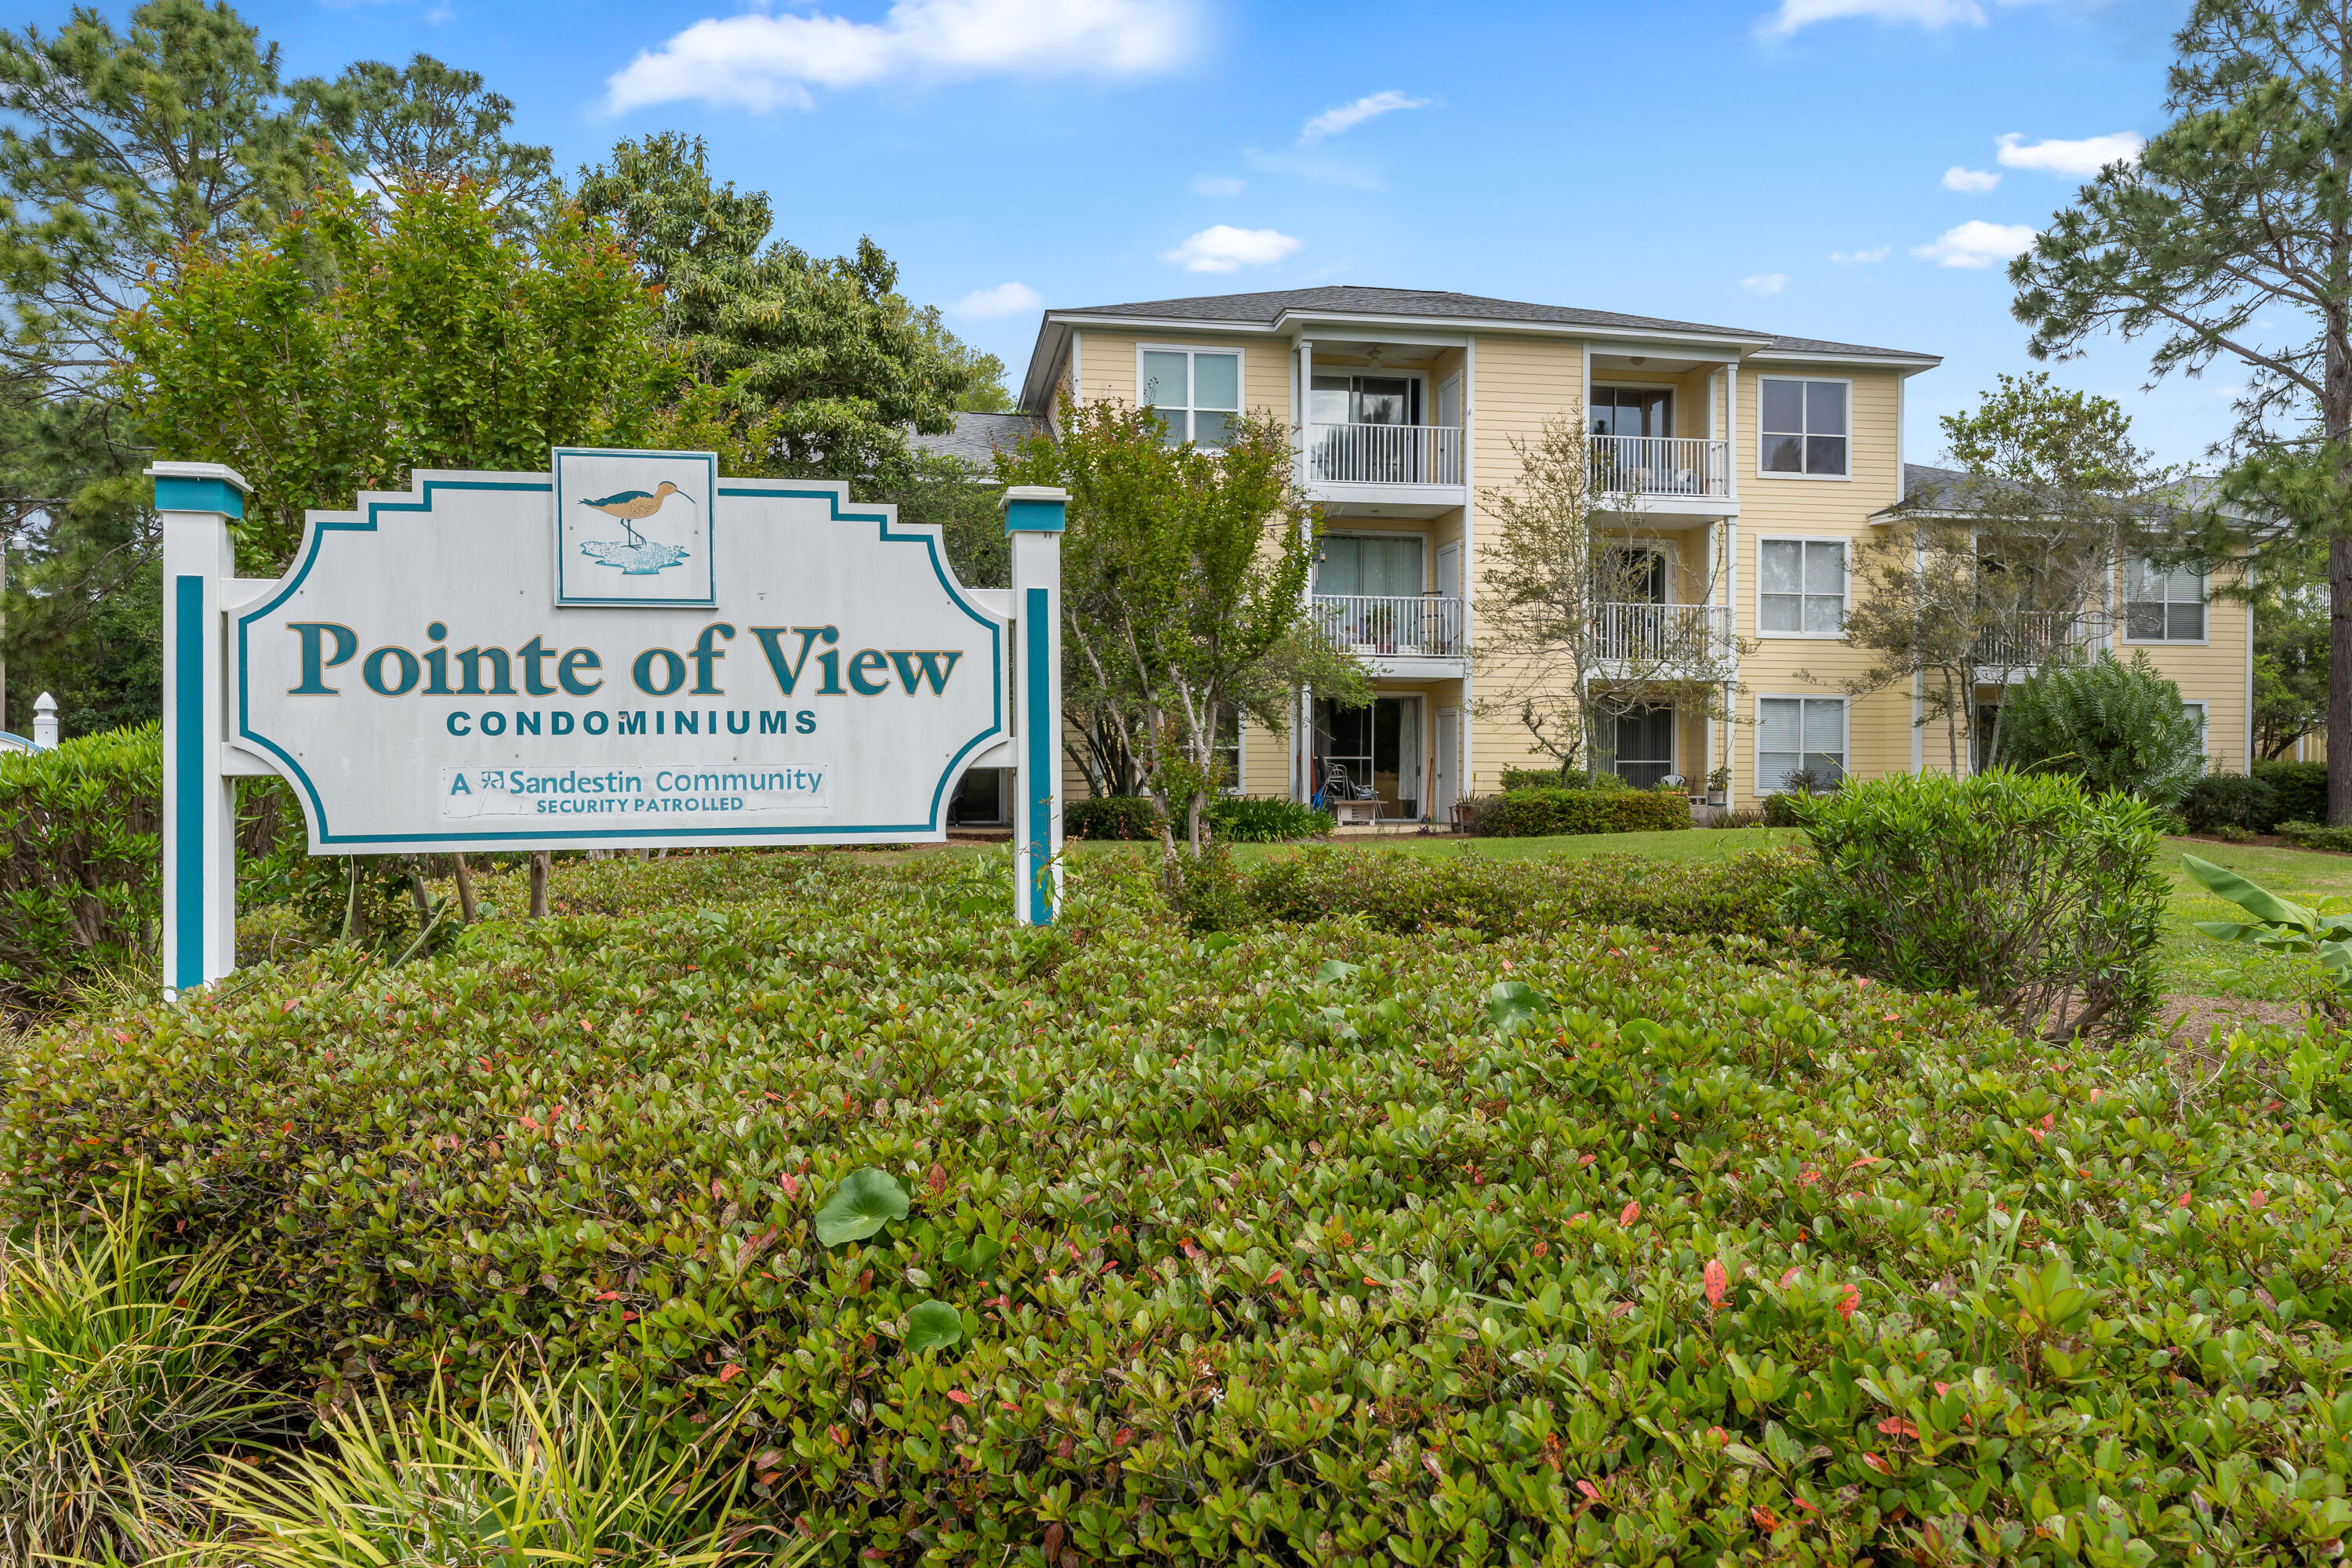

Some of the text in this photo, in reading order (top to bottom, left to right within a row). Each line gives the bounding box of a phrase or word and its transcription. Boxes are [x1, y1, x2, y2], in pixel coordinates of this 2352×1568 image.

[285, 621, 963, 697] Pointe of View
[447, 710, 816, 736] CONDOMINIUMS
[451, 769, 822, 795] A Sandestin Community
[537, 797, 743, 813] SECURITY PATROLLED
